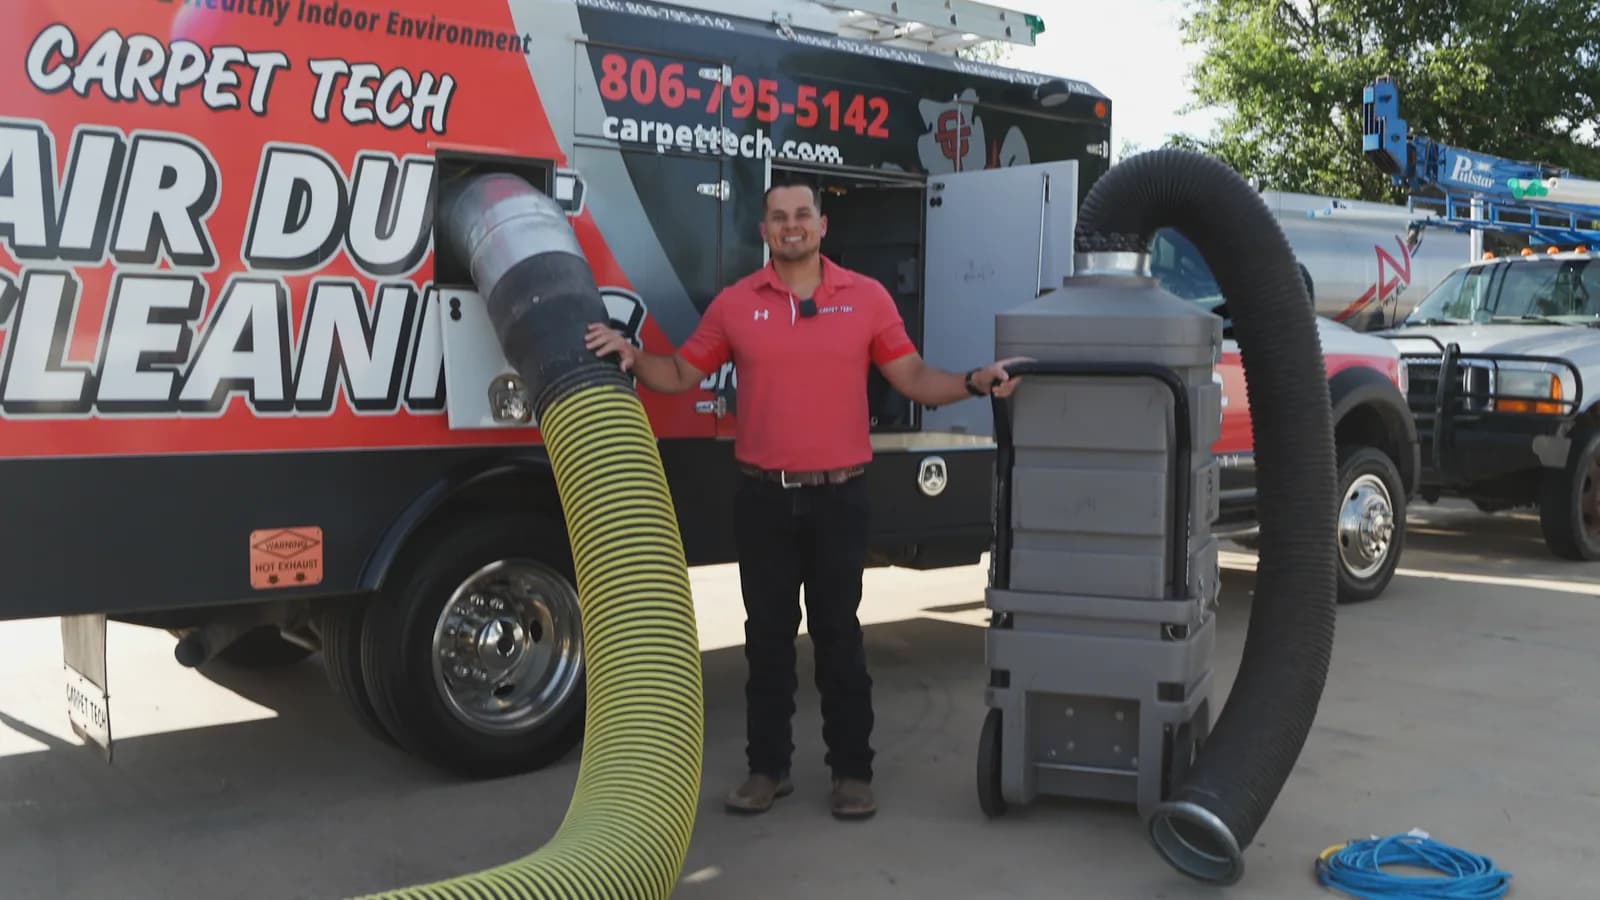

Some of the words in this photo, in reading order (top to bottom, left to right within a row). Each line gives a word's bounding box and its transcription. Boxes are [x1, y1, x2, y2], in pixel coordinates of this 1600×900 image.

[297, 0, 381, 32] Indoor
[386, 10, 533, 55] Environment
[26, 24, 290, 116] CARPET
[307, 58, 456, 134] TECH
[599, 52, 890, 139] 806-795-5142
[602, 115, 844, 165] carpettech.com
[1450, 154, 1496, 189] Pulstar
[255, 561, 275, 574] HOT
[278, 558, 319, 572] EXHAUST
[264, 539, 309, 552] WARNING
[66, 681, 88, 719] CARPET
[90, 700, 107, 734] TECH
